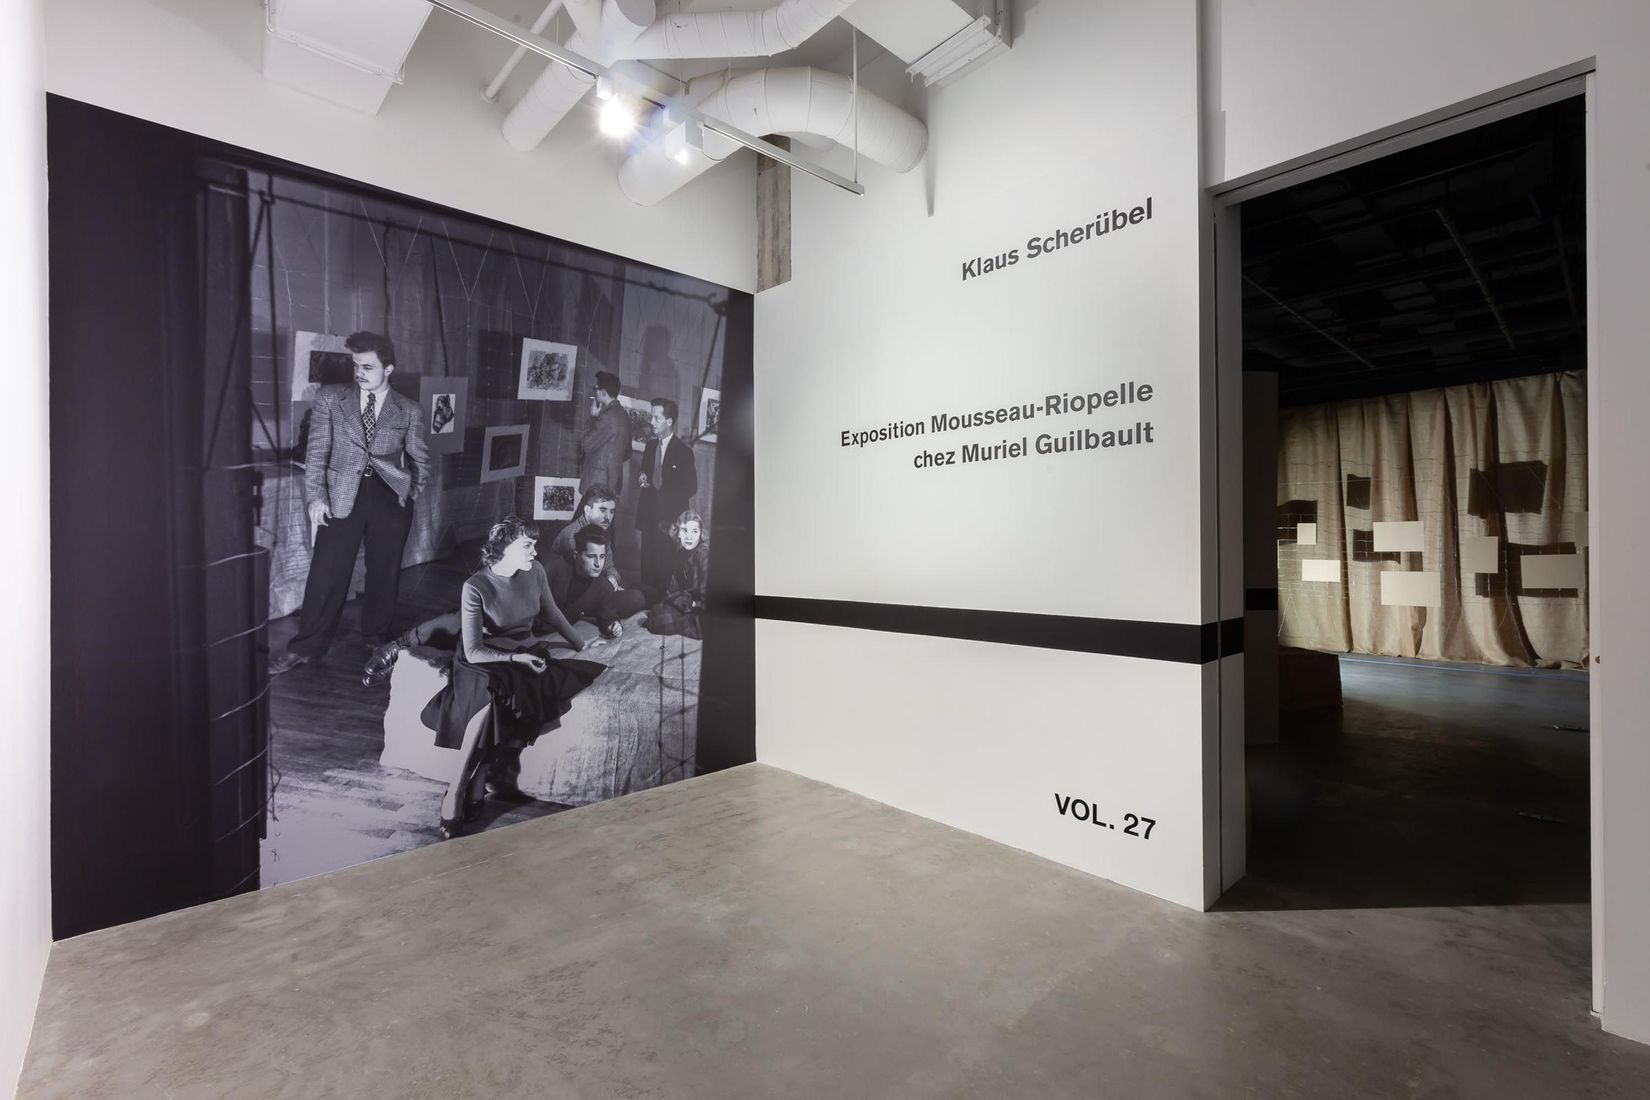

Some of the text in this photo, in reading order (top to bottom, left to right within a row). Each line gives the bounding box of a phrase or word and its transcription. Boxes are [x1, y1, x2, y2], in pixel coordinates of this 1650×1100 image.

[962, 196, 1153, 280] Klaus Scherübel
[841, 381, 1154, 448] Exposition Mousseau-Riopelle
[913, 421, 1154, 469] chez Muriel Guilbault
[1054, 793, 1156, 840] VOL. 27
